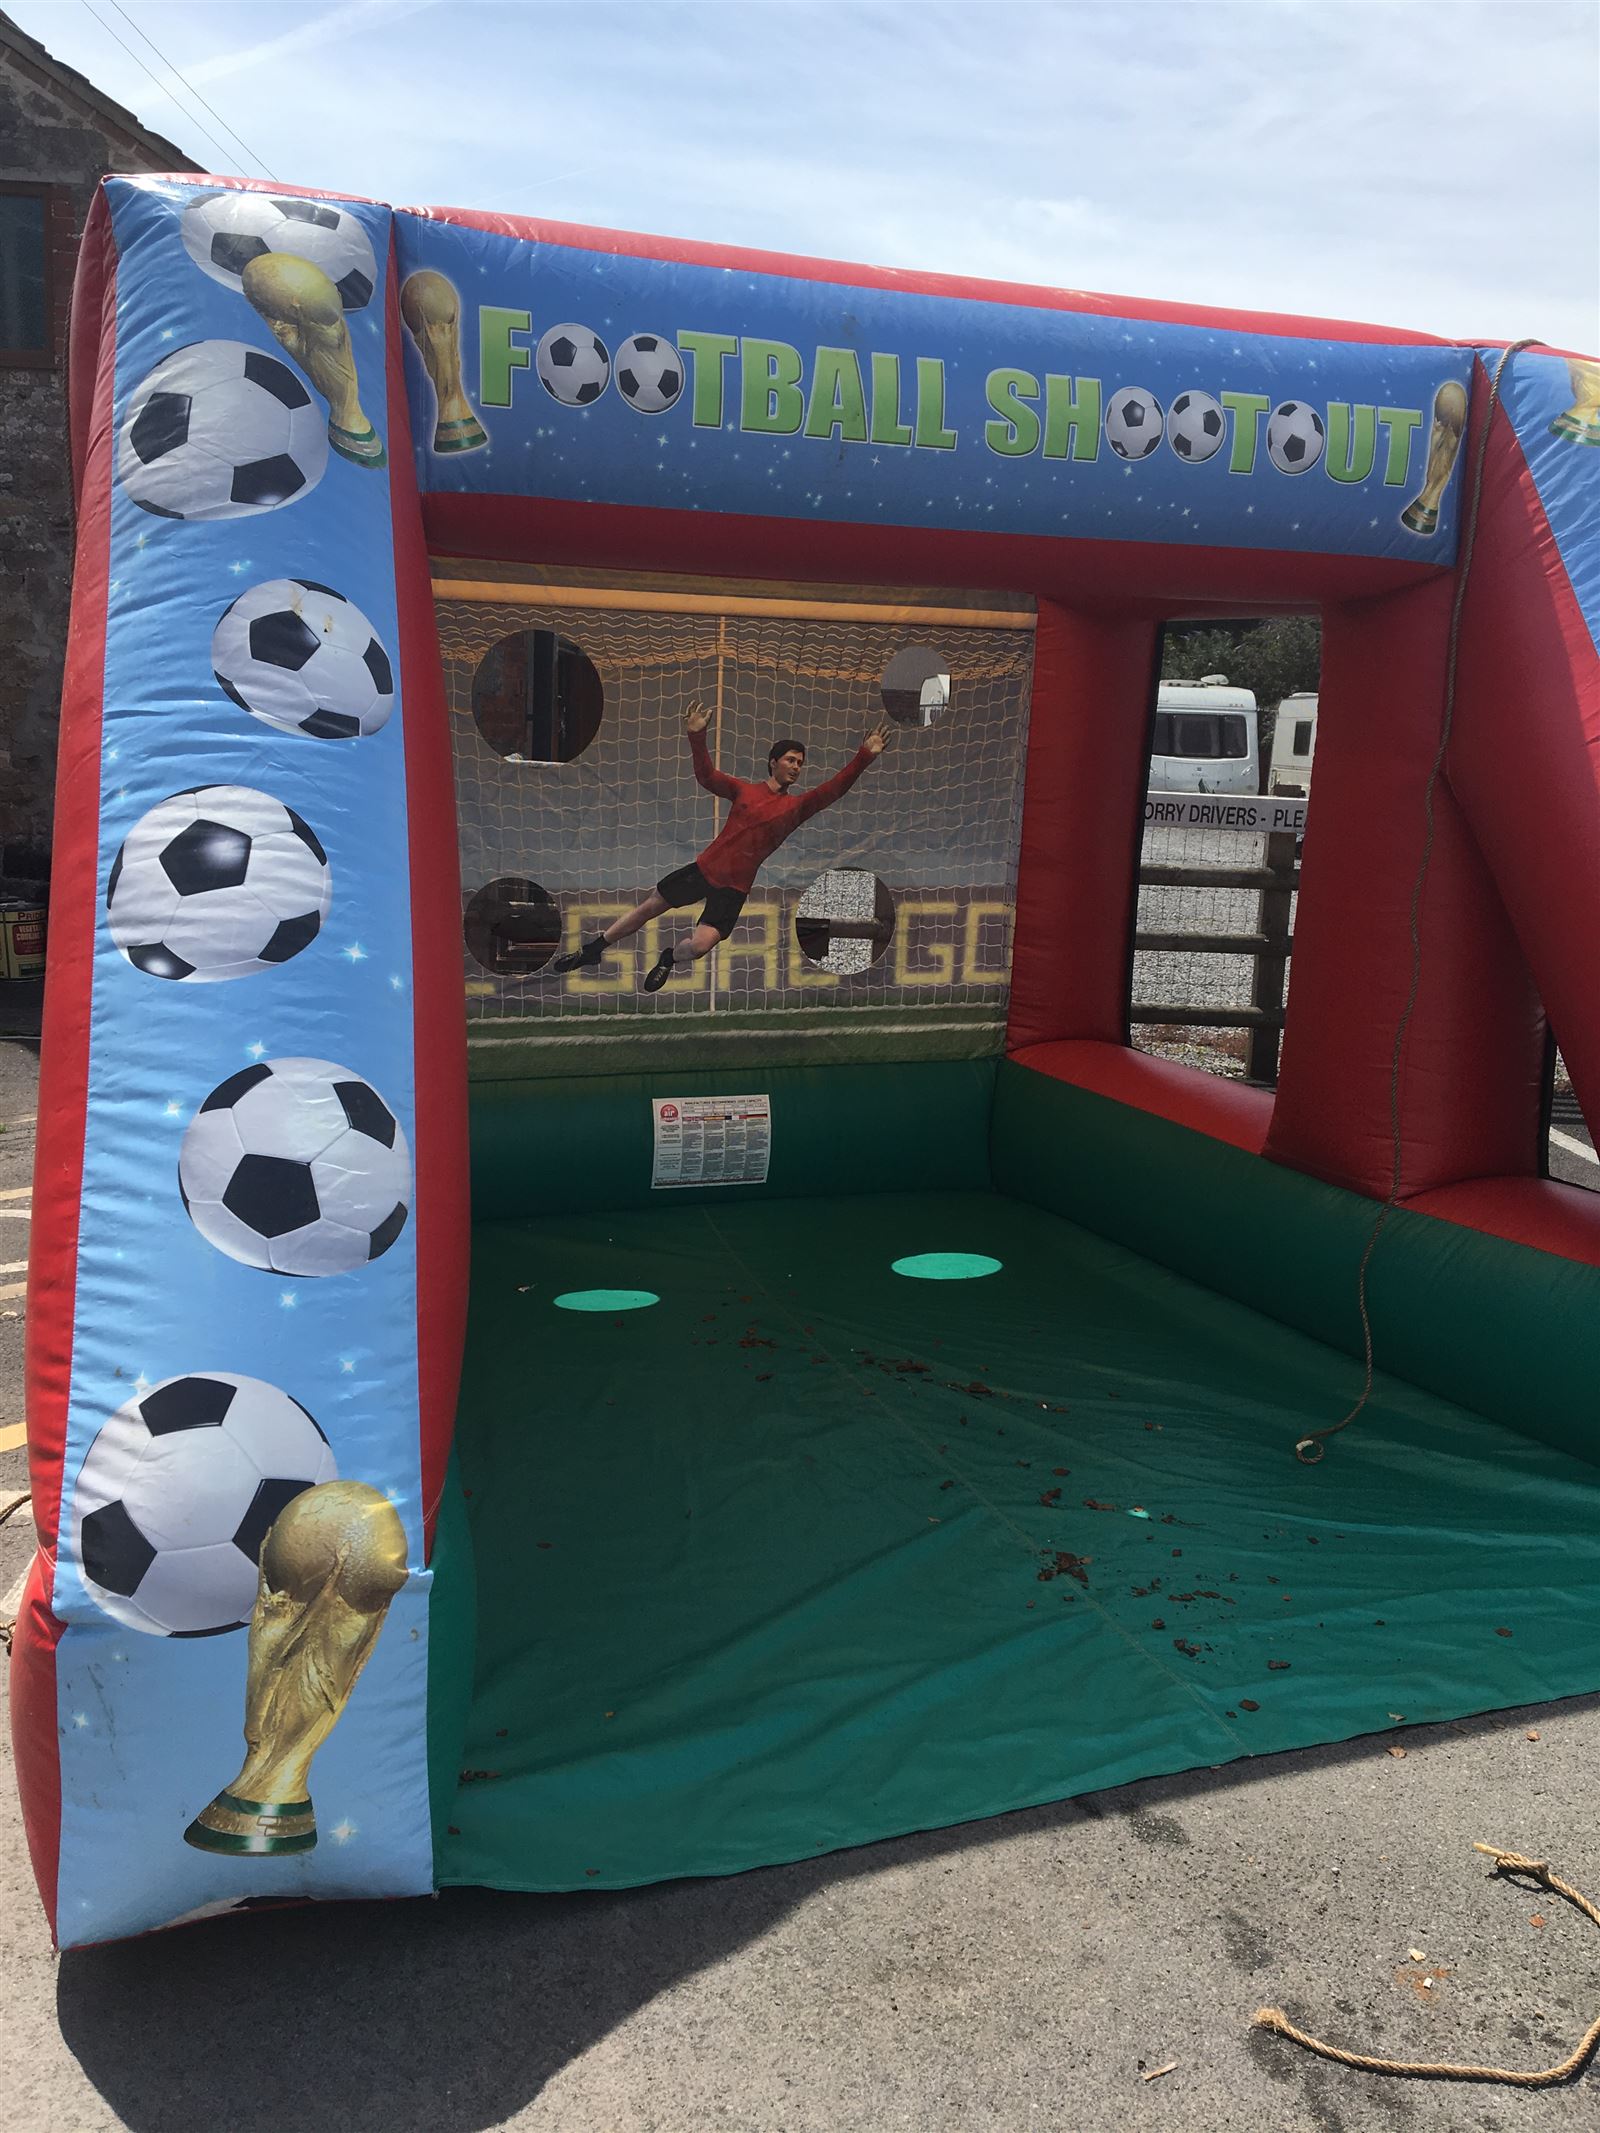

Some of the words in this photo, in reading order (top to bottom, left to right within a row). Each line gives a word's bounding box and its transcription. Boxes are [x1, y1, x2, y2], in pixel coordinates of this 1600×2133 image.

[479, 305, 958, 451] FOOTBALL
[984, 367, 1423, 488] SHOOTOUT
[1144, 802, 1185, 822] ORRY
[1189, 803, 1257, 826] DRIVERS
[1273, 808, 1308, 828] PLE
